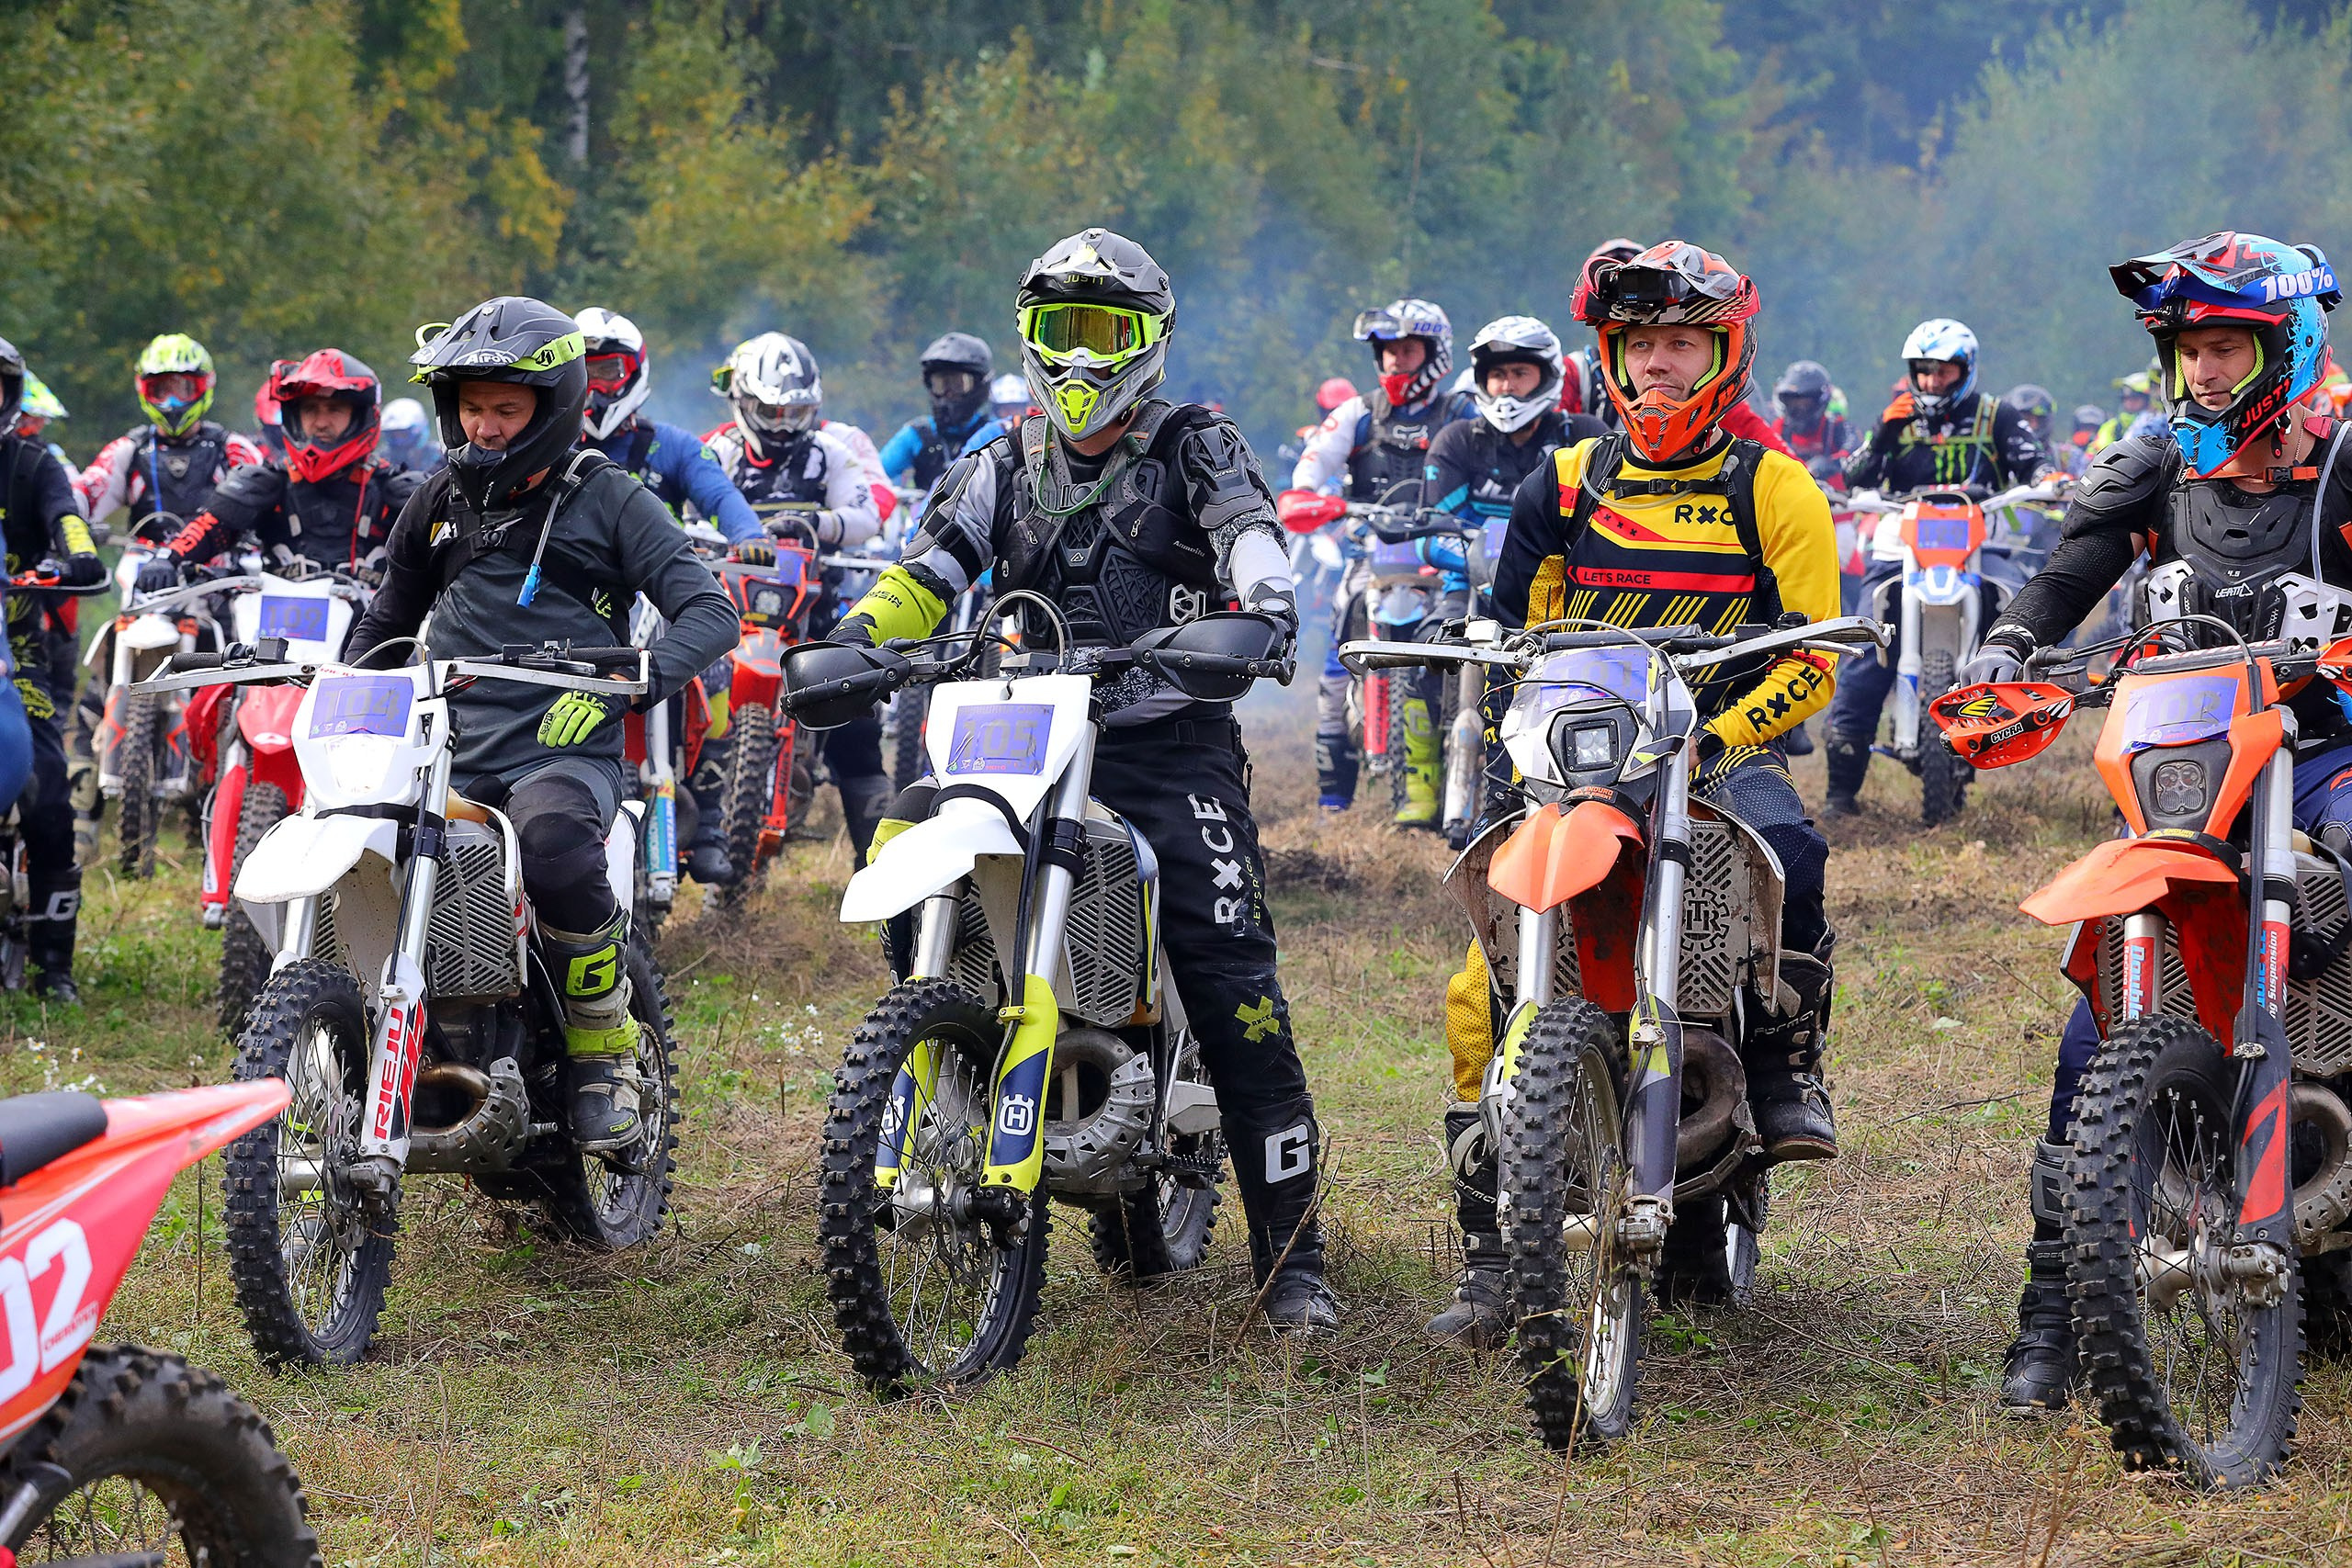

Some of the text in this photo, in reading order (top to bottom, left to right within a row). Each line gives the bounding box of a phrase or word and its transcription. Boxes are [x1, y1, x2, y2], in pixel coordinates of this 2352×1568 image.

[1064, 274, 1104, 285] JUST1
[2261, 266, 2334, 302] 100%
[2241, 378, 2290, 429] JUST1
[1674, 504, 1736, 526] RXC
[1584, 571, 1651, 585] LET'S RACE
[267, 605, 322, 630] 109
[324, 687, 401, 721] 104
[963, 718, 1039, 758] 105
[1990, 722, 2024, 744] CYCRA
[566, 943, 616, 996] G
[2267, 931, 2278, 1000] Suspension
[374, 1008, 403, 1140] RIEJU
[1265, 1123, 1311, 1184] G
